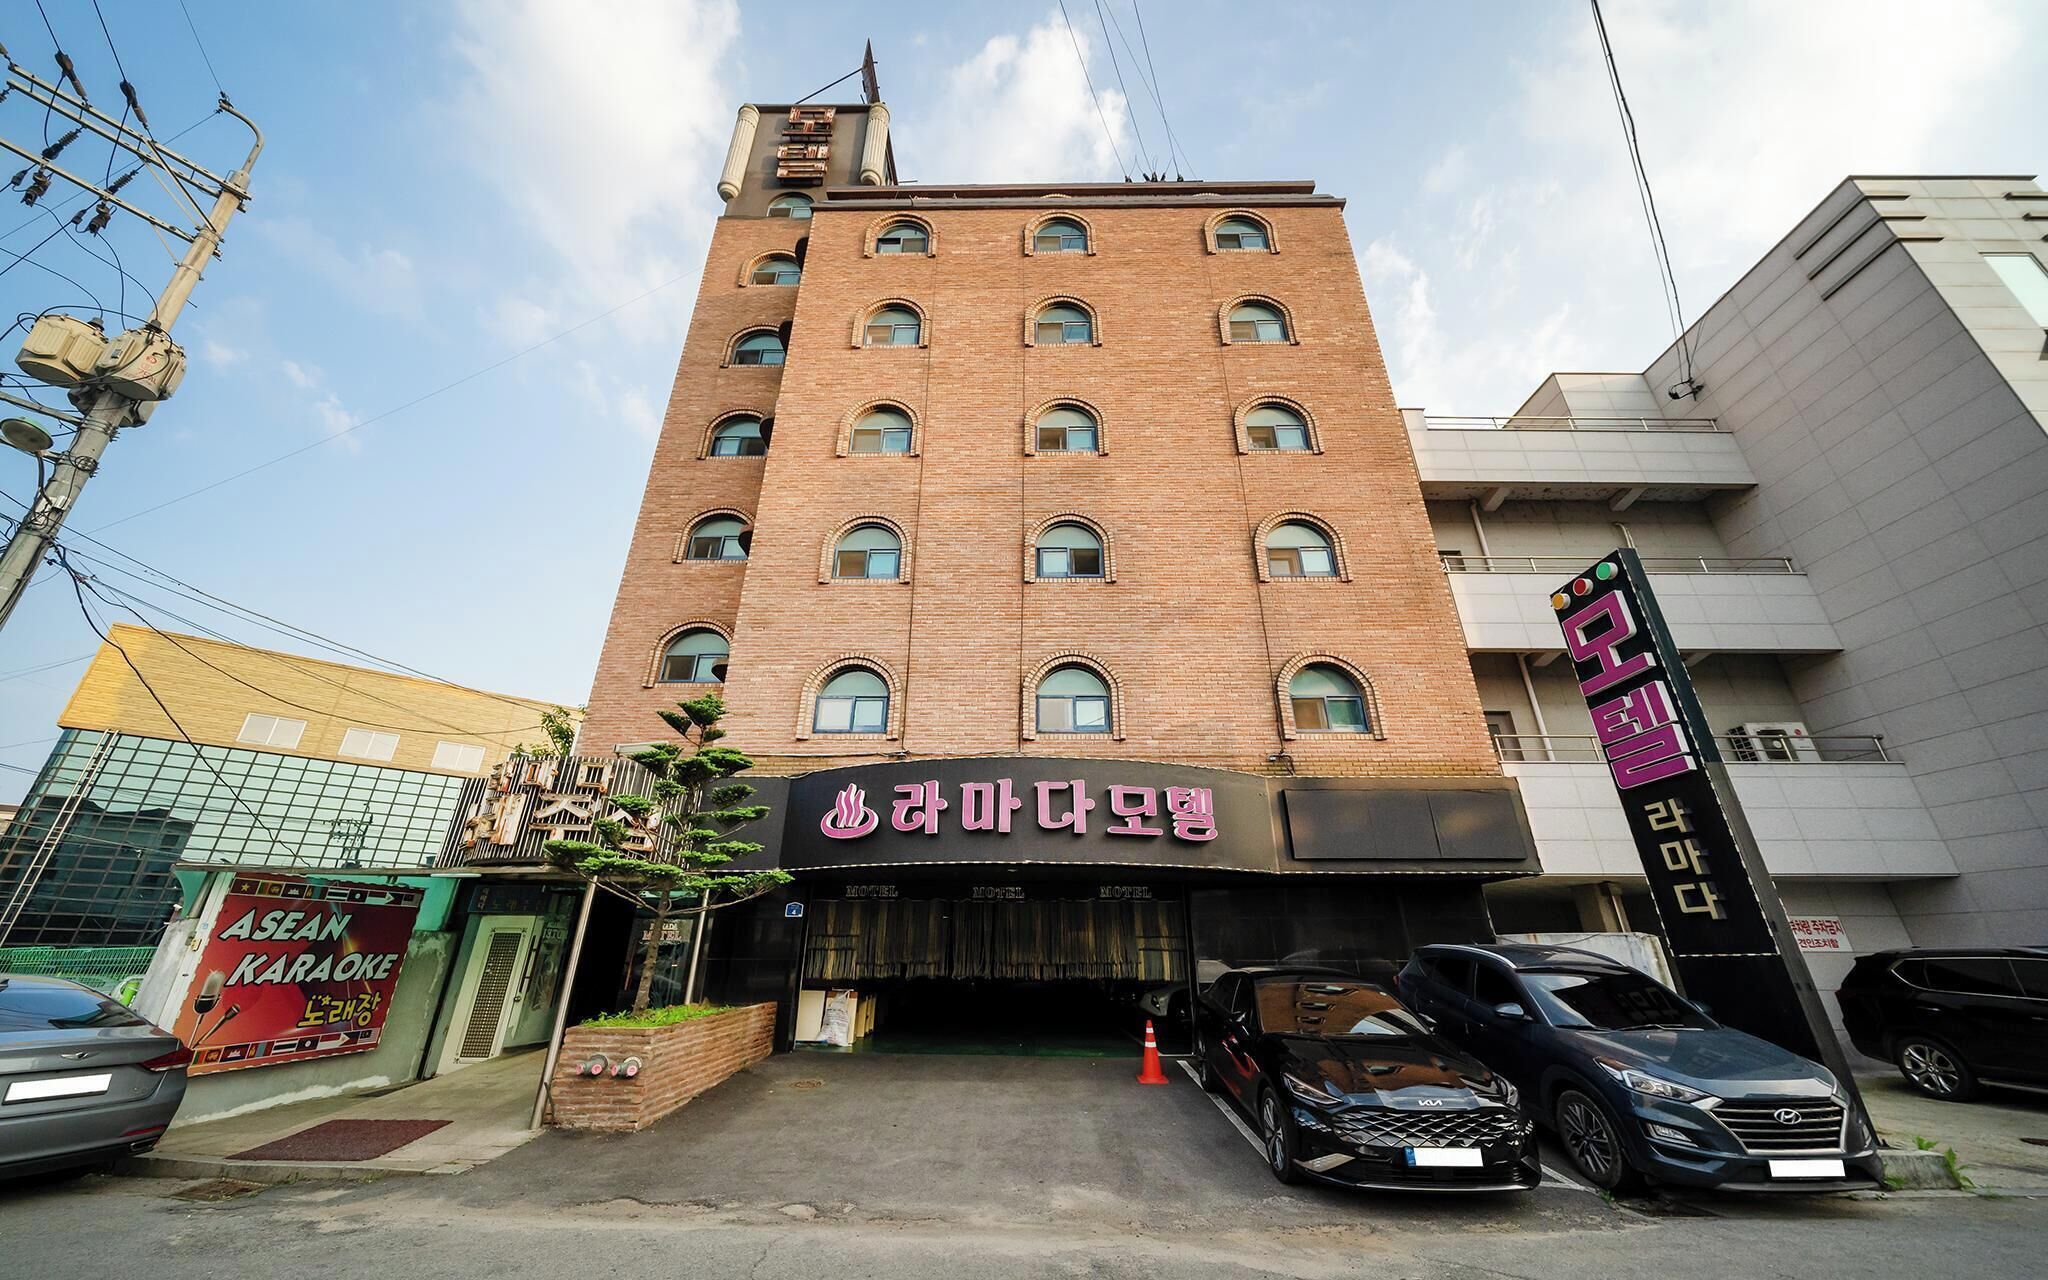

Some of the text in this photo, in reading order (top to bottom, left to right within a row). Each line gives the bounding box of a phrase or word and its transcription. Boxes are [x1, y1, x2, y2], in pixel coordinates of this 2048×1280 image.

[776, 106, 836, 181] 모텔
[1562, 590, 1697, 789] 모텔
[1644, 798, 1726, 921] 라마다
[846, 885, 898, 897] MOTEL
[972, 886, 1025, 899] MOTEL
[1099, 885, 1152, 898] MOTEL
[219, 907, 352, 942] ASEAN
[642, 930, 682, 941] MTEL
[223, 952, 399, 987] KARAOKE
